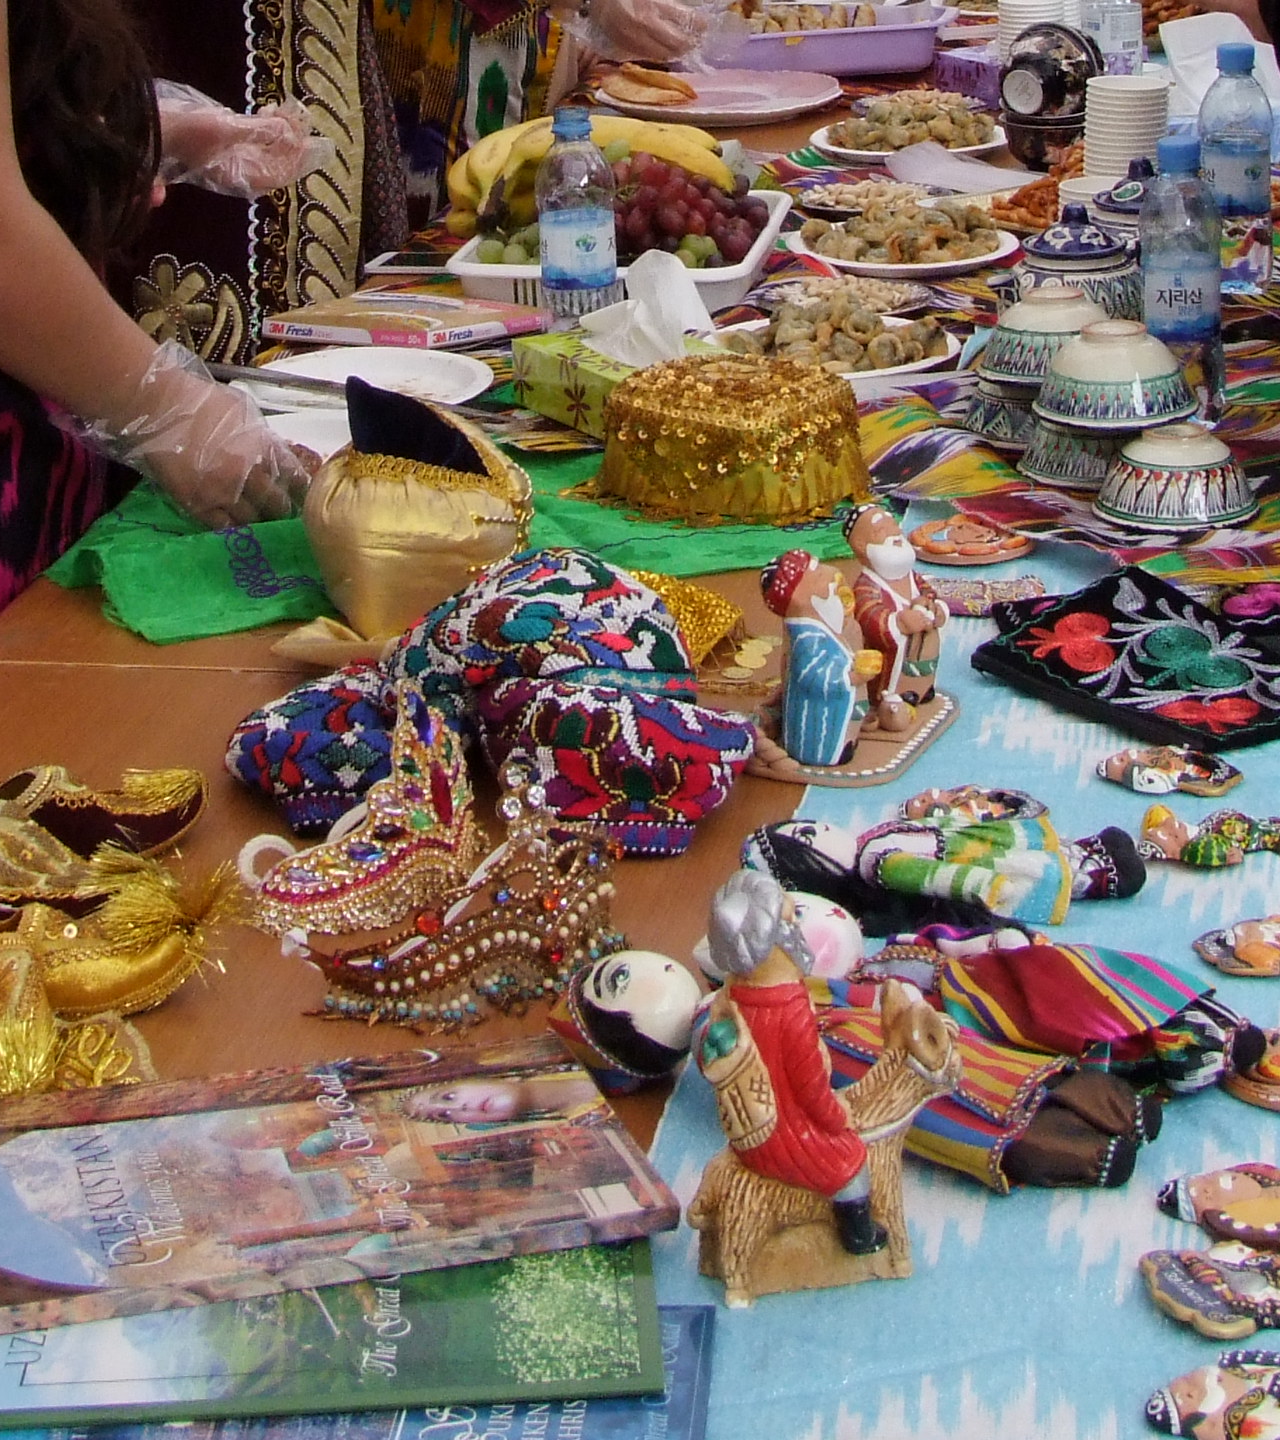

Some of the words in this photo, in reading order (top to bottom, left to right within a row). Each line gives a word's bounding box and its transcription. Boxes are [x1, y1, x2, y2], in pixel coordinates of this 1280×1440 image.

[1156, 287, 1202, 308] 지리산
[269, 323, 285, 335] 3M
[286, 324, 313, 337] Fresh
[433, 332, 447, 344] 3M
[448, 329, 473, 342] Fresh
[305, 1074, 355, 1113] Road
[356, 1156, 410, 1195] Great
[66, 1134, 148, 1268] UZBEKISTAN
[363, 1287, 412, 1337] Great
[361, 1342, 397, 1377] The
